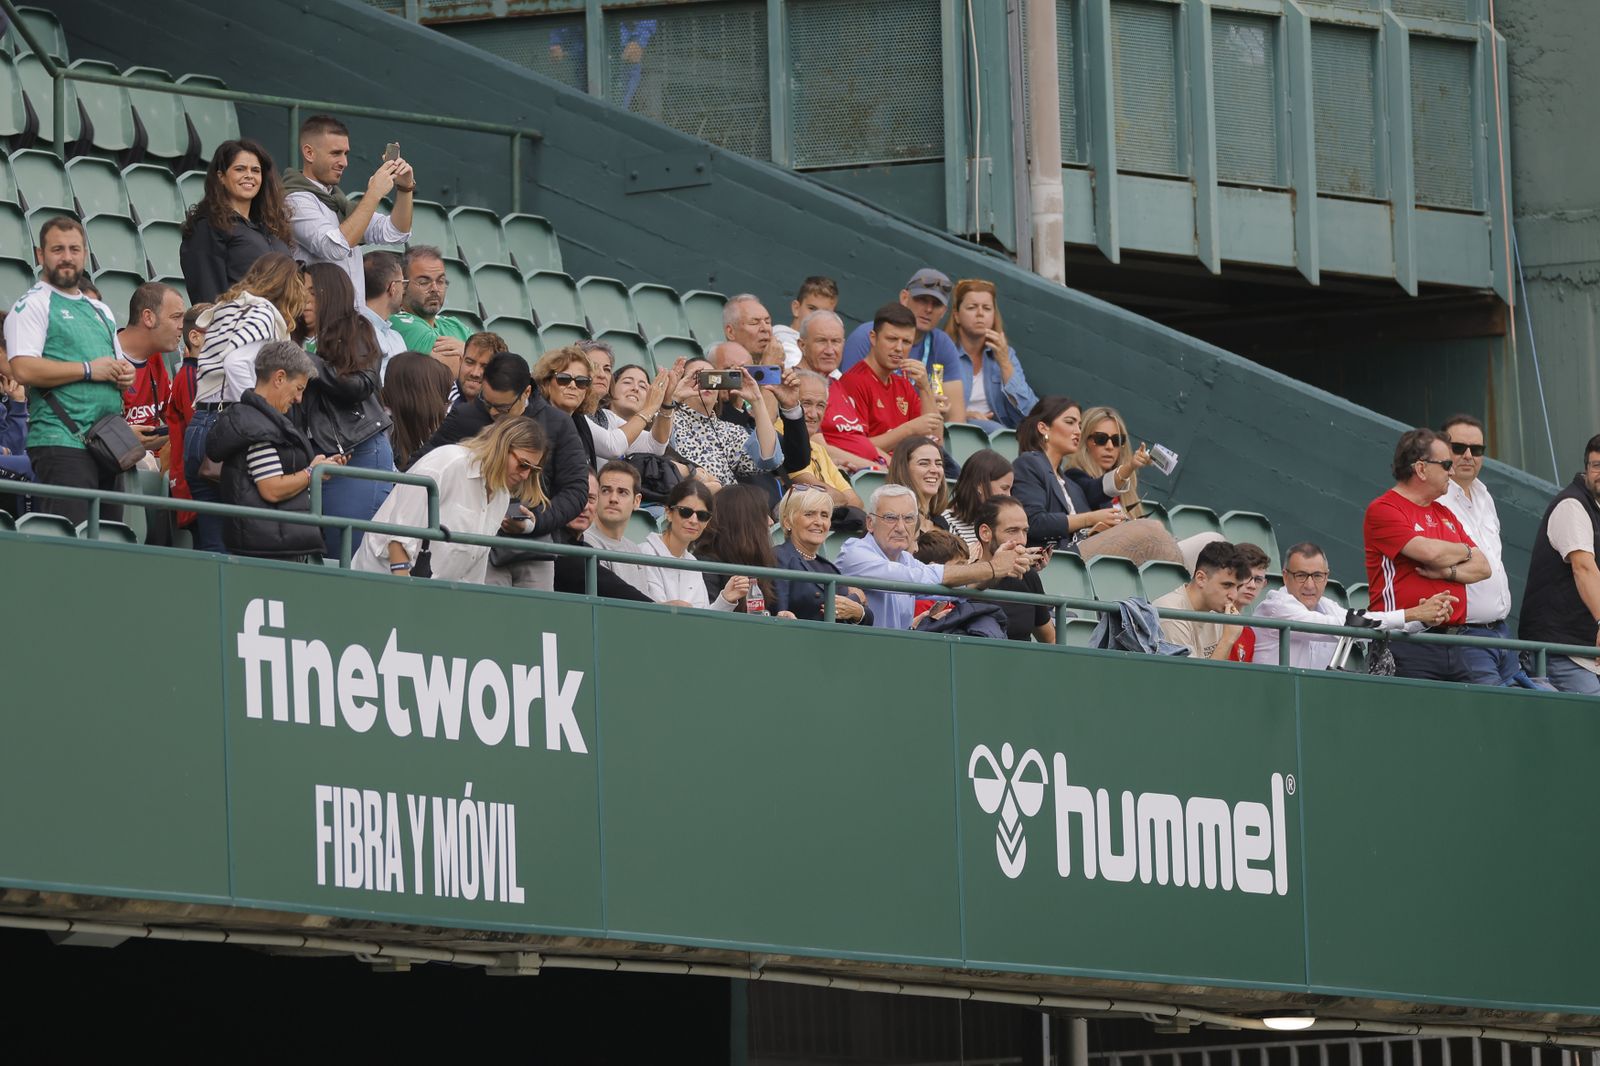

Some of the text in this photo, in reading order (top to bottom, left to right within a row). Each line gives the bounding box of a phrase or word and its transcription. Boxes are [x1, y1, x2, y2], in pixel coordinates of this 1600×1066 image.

[237, 598, 589, 754] finetwork
[315, 781, 525, 904] FIBRA Y MÓVIL
[1053, 752, 1288, 896] hummel
